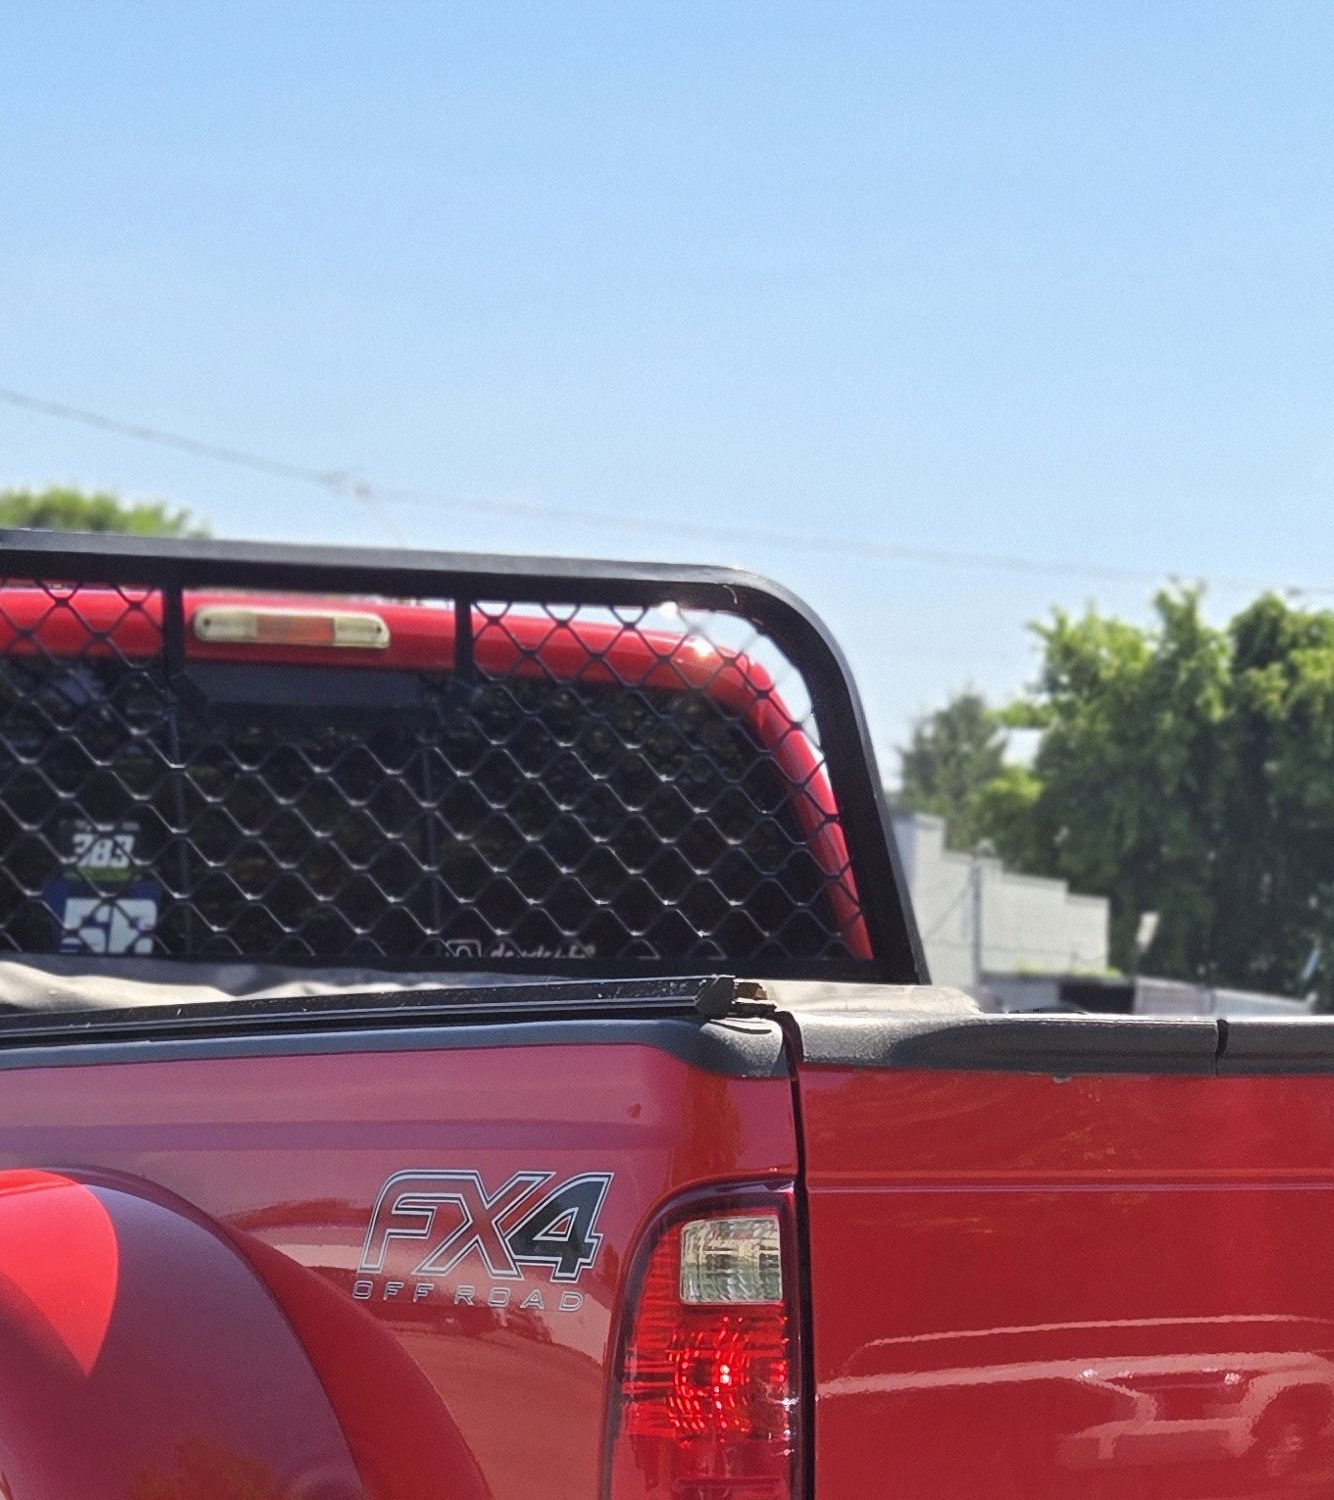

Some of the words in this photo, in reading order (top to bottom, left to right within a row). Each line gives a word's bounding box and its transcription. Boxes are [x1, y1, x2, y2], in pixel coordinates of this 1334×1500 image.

[357, 1169, 614, 1283] FX4
[351, 1280, 435, 1303] OFF
[454, 1285, 584, 1312] ROAD
